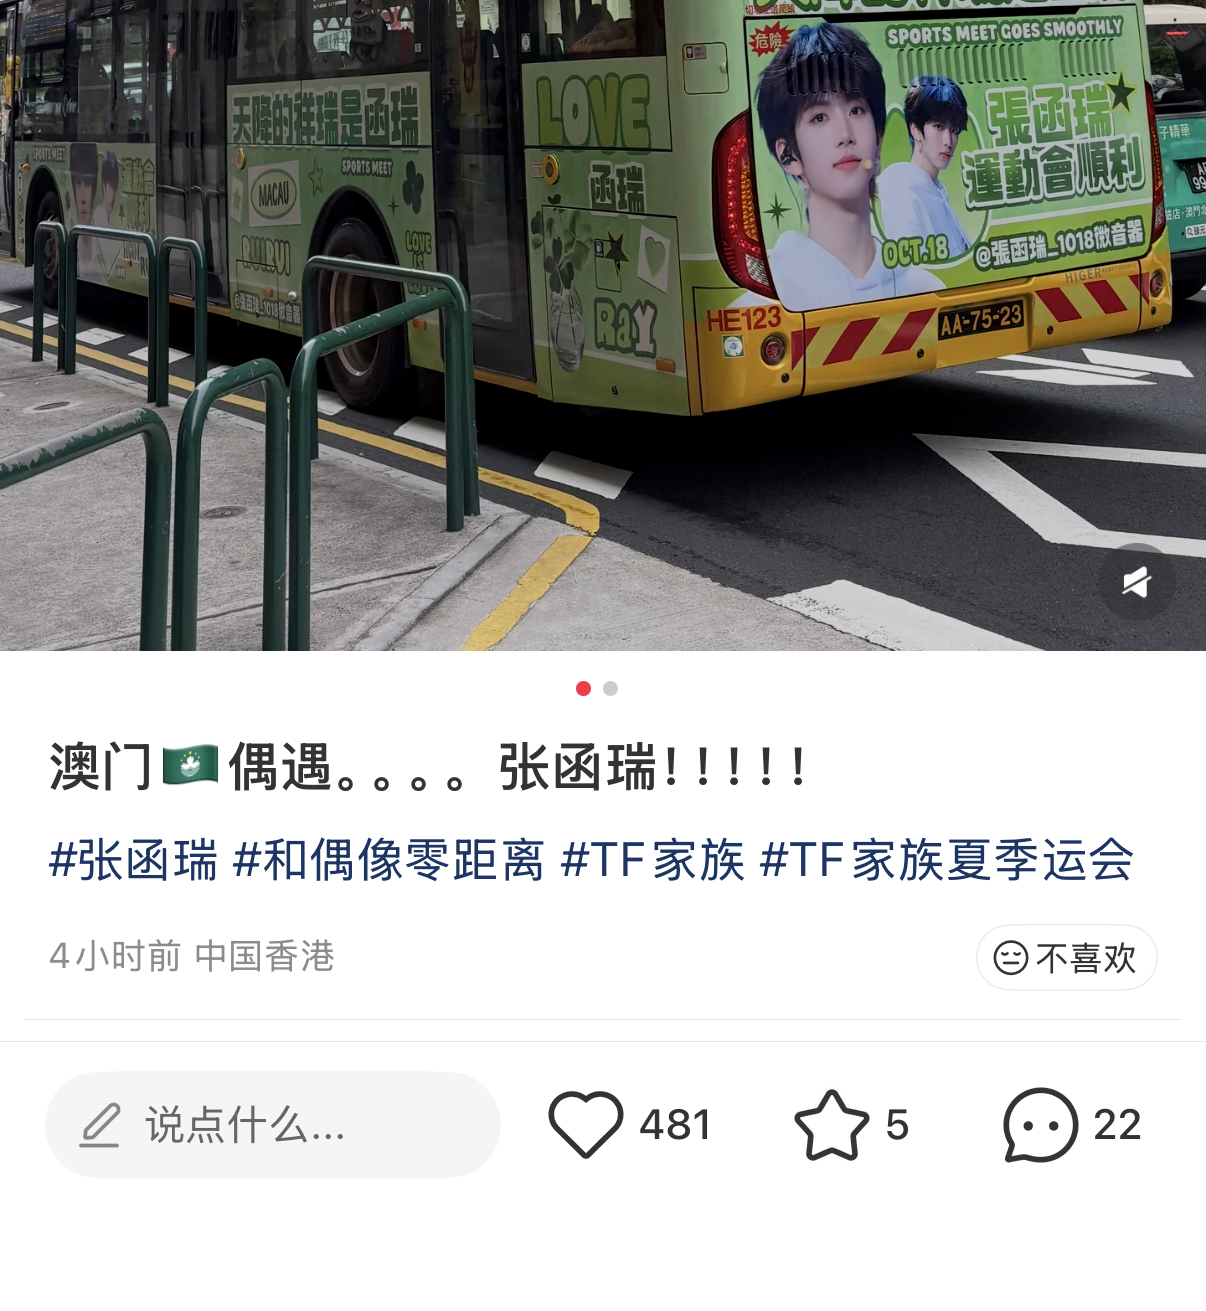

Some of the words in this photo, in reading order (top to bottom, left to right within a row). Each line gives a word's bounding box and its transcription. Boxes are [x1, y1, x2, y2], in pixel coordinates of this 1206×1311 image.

[756, 33, 783, 49] 危險
[888, 26, 952, 45] SPORTS
[955, 24, 997, 42] MEET
[1001, 22, 1041, 40] GOES
[1043, 18, 1122, 37] SMOOTHLY
[232, 85, 419, 148] 天降的祥瑞是函瑞
[536, 72, 651, 155] LOVE
[986, 82, 1113, 147] 張函瑞
[342, 160, 370, 174] SPORTS
[371, 161, 393, 175] MEET
[963, 135, 1144, 205] 運動會順利
[258, 180, 290, 207] MACAU
[589, 161, 646, 214] 函瑞
[241, 236, 291, 276] RUIRUI
[405, 230, 432, 254] LOVE
[882, 234, 949, 269] OCT.18
[1065, 268, 1102, 283] HIGER
[707, 305, 782, 332] HE123
[940, 303, 1023, 337] AA-75-23
